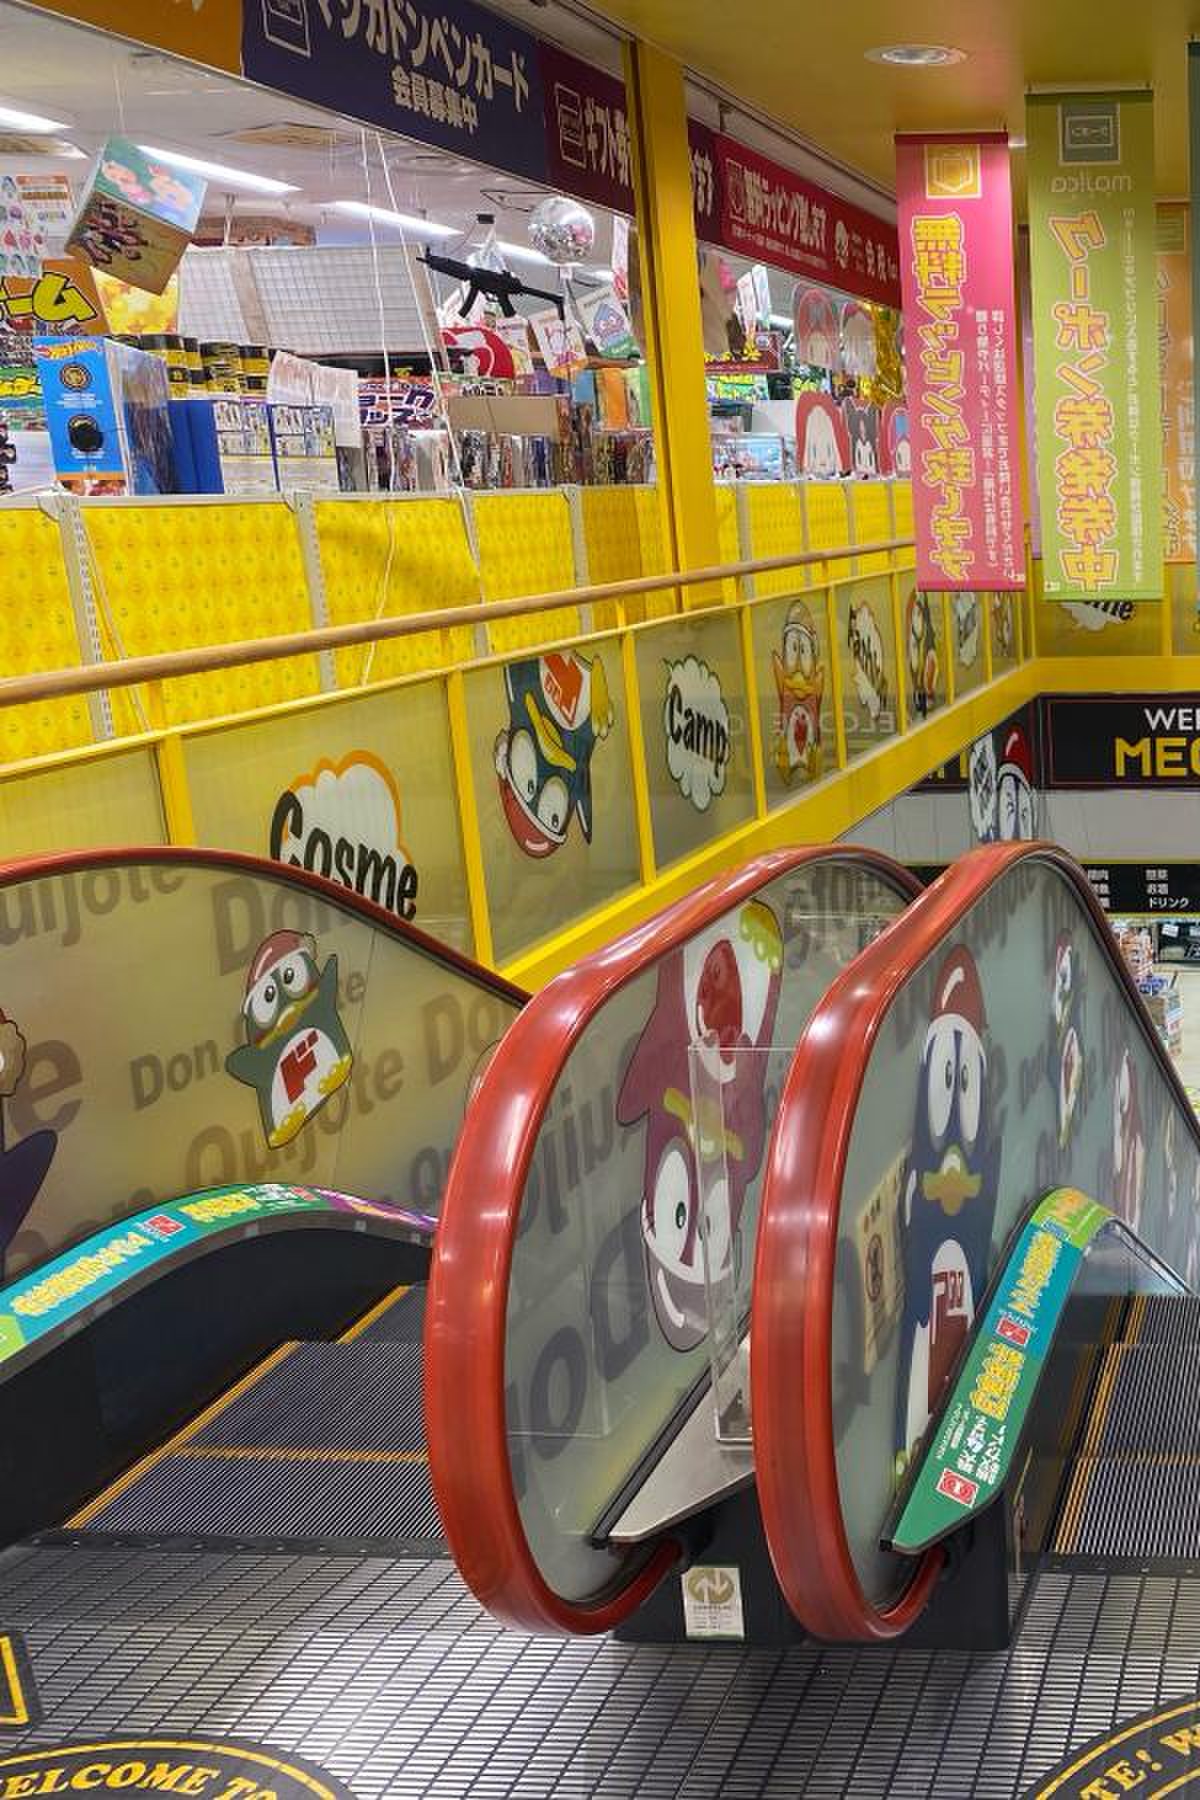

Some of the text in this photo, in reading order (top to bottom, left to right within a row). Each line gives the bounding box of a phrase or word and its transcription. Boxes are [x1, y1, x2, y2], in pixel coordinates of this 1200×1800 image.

[391, 65, 478, 134] 会員募集中
[668, 684, 729, 777] Camp
[270, 791, 419, 920] Cosme
[1149, 897, 1190, 909] ドリンク
[129, 1039, 223, 1111] Don
[0, 1761, 223, 1800] ELCOME
